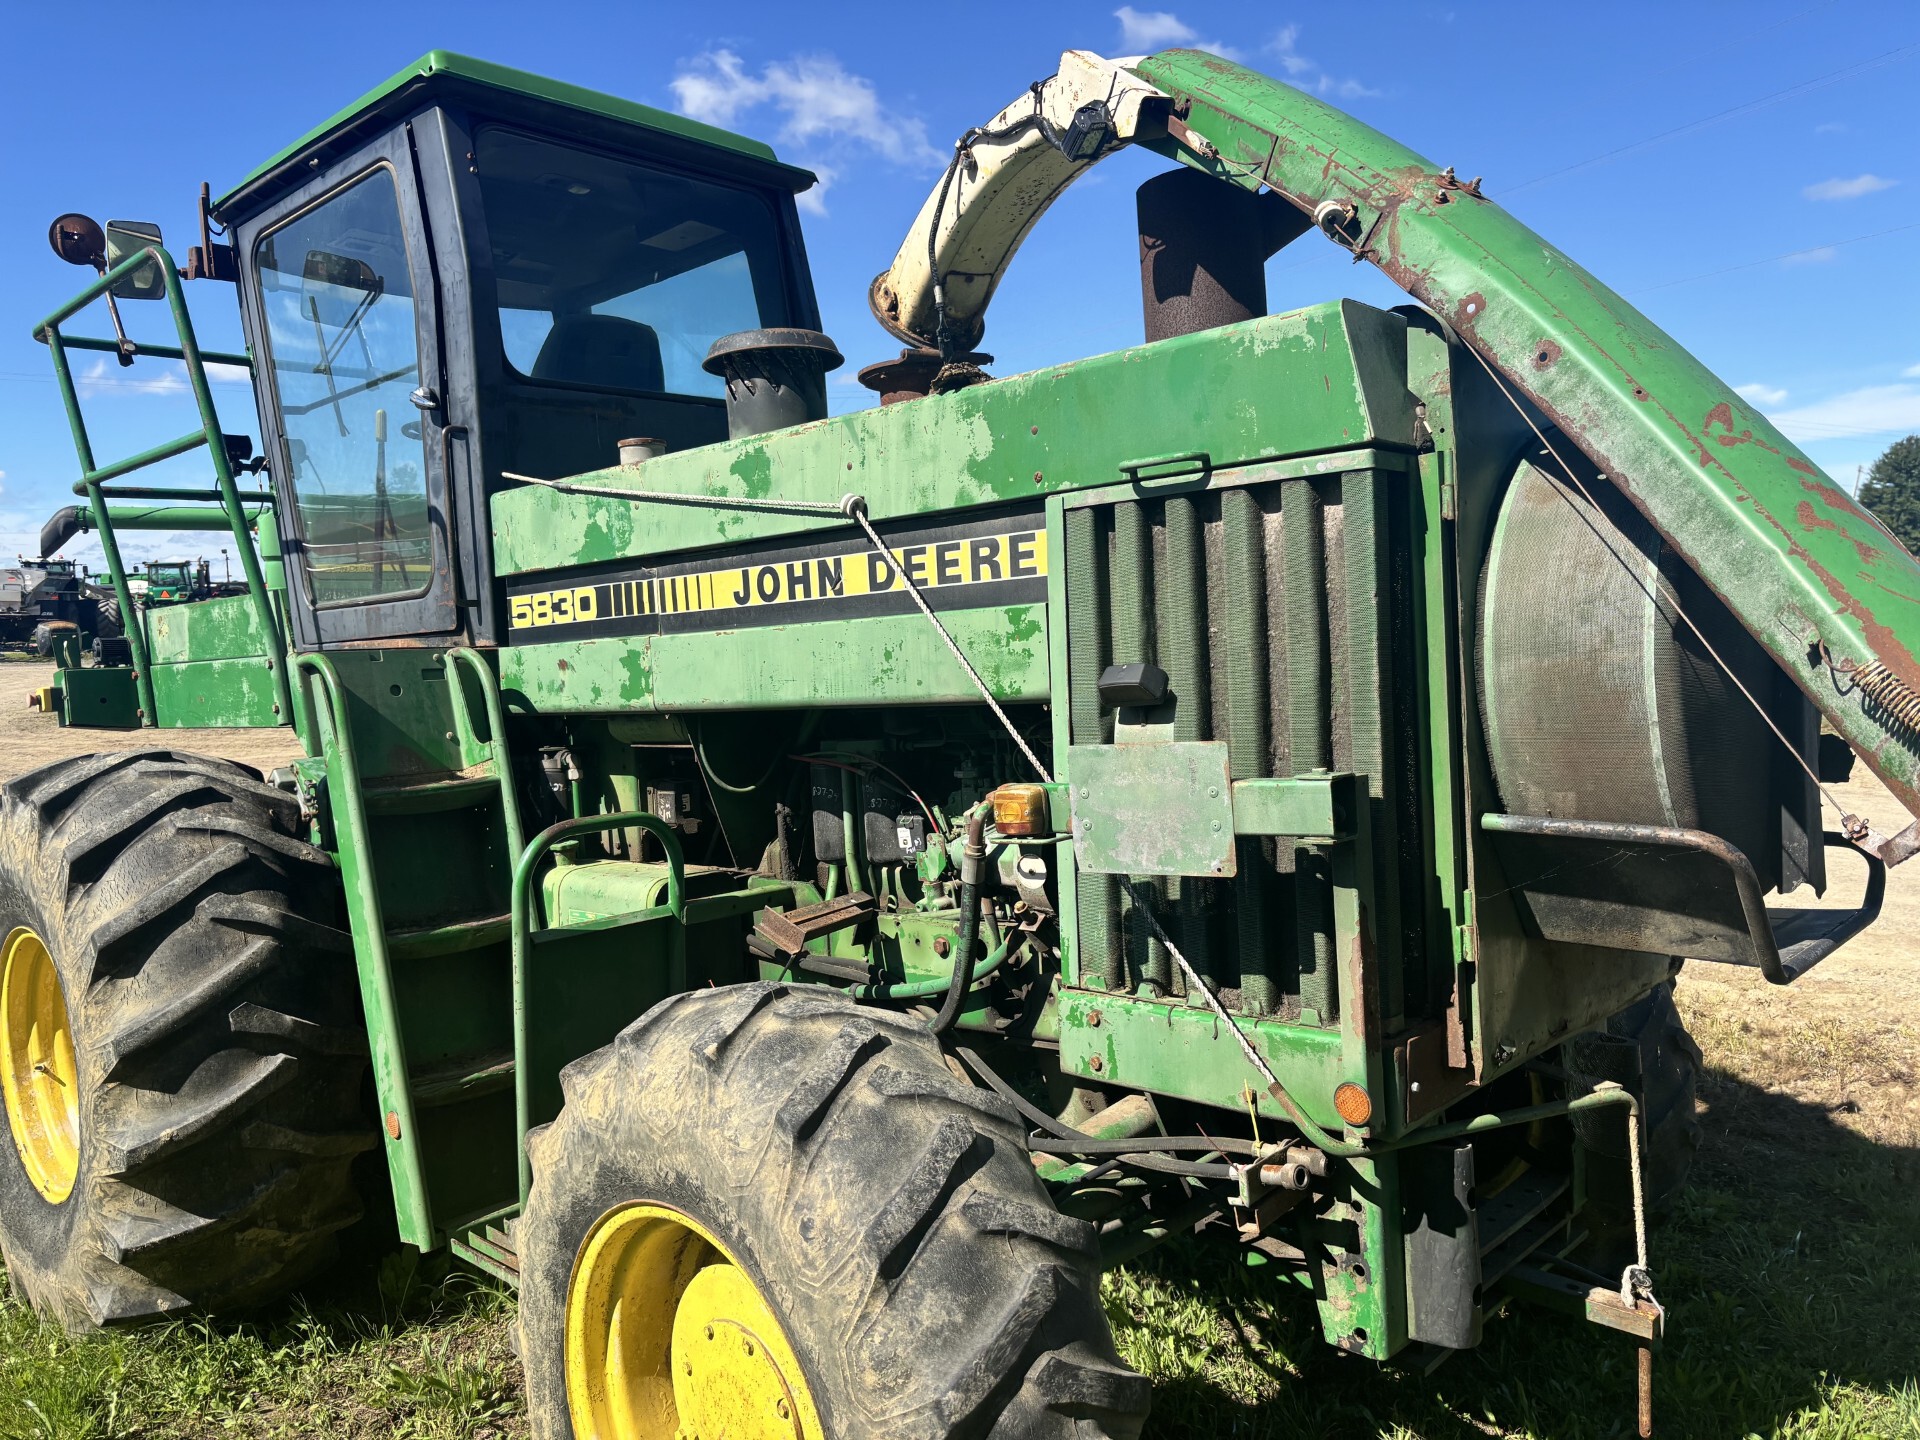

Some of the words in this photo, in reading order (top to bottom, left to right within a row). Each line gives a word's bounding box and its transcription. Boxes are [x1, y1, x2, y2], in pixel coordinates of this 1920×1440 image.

[511, 586, 598, 629] 5830
[733, 556, 845, 606] JOHN
[867, 532, 1038, 593] DEERE
